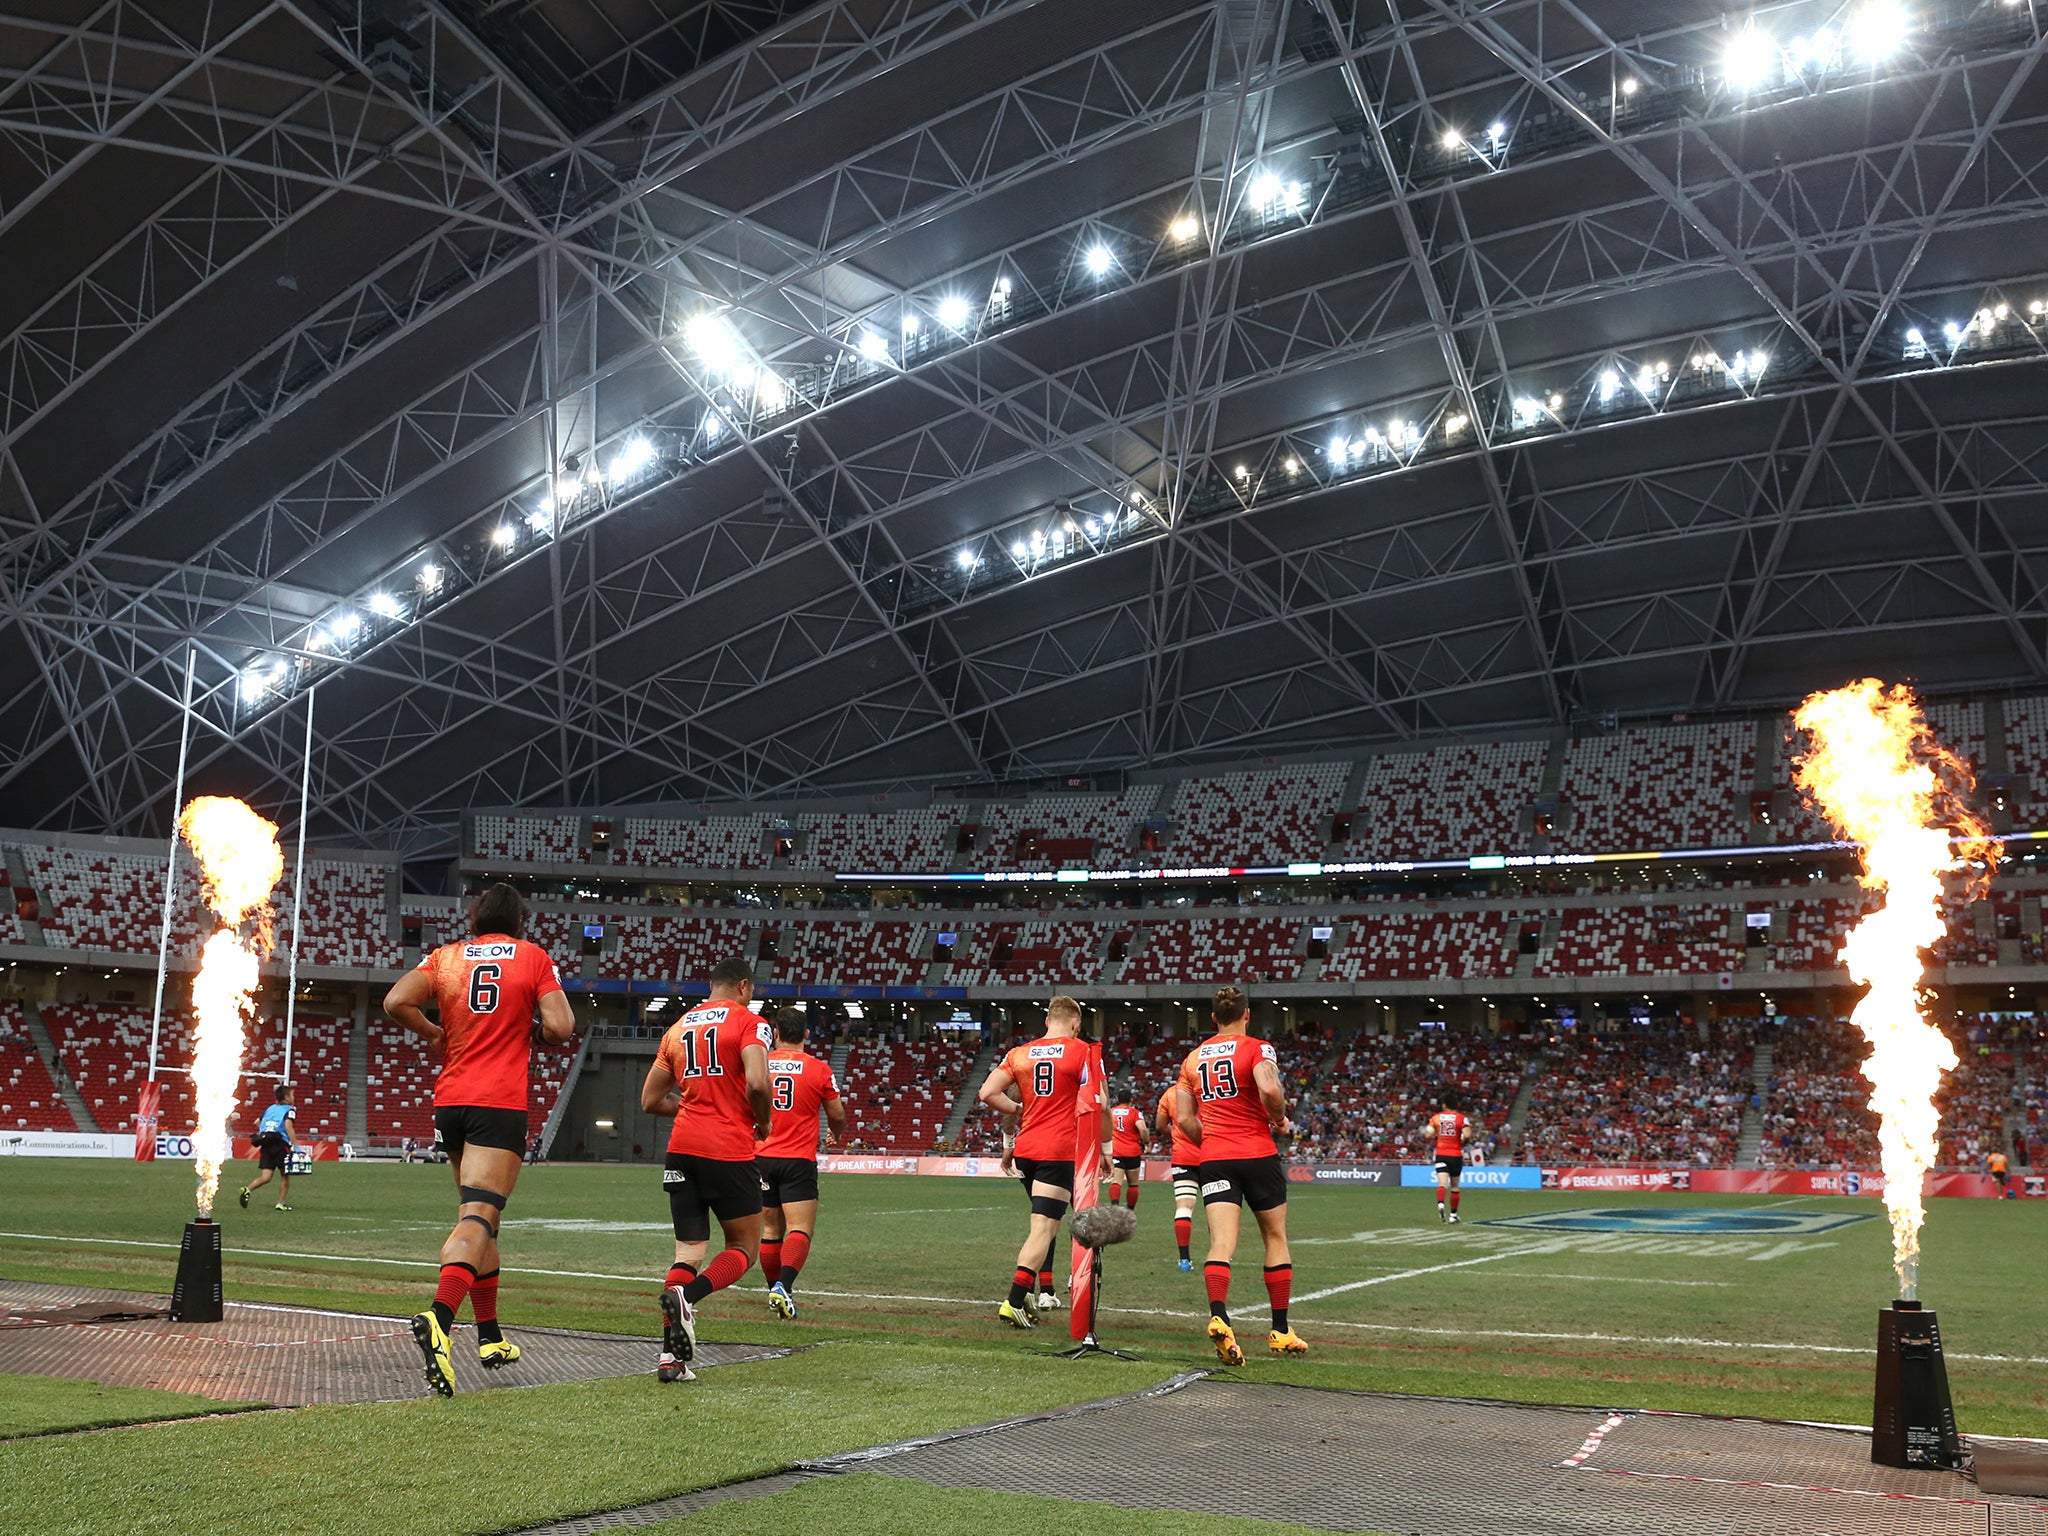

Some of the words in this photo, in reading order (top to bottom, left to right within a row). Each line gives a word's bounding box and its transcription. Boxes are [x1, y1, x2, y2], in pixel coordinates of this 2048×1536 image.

[984, 872, 1006, 881] EAST
[1007, 872, 1031, 881] WEST
[1139, 869, 1160, 878] LAST
[1163, 868, 1188, 878] TRAIN
[465, 945, 513, 958] SECOM
[468, 963, 502, 1014] 6
[684, 1009, 726, 1024] SECOM
[680, 1026, 724, 1078] 11
[1030, 1047, 1063, 1056] SECOM
[1201, 1043, 1236, 1057] SECOM
[768, 1062, 802, 1072] SECOM
[1033, 1060, 1054, 1097] 8
[1196, 1057, 1239, 1102] 13
[772, 1076, 795, 1111] 3
[1116, 1115, 1125, 1132] 1
[1440, 1121, 1456, 1137] 12
[156, 1137, 193, 1156] ECO
[837, 1160, 865, 1171] BREAK
[867, 1160, 884, 1169] THE
[885, 1159, 904, 1169] LINE
[1315, 1167, 1382, 1182] canterbury
[1572, 1175, 1614, 1187] BREAK
[1616, 1174, 1641, 1186] THE
[1642, 1173, 1671, 1185] LINE
